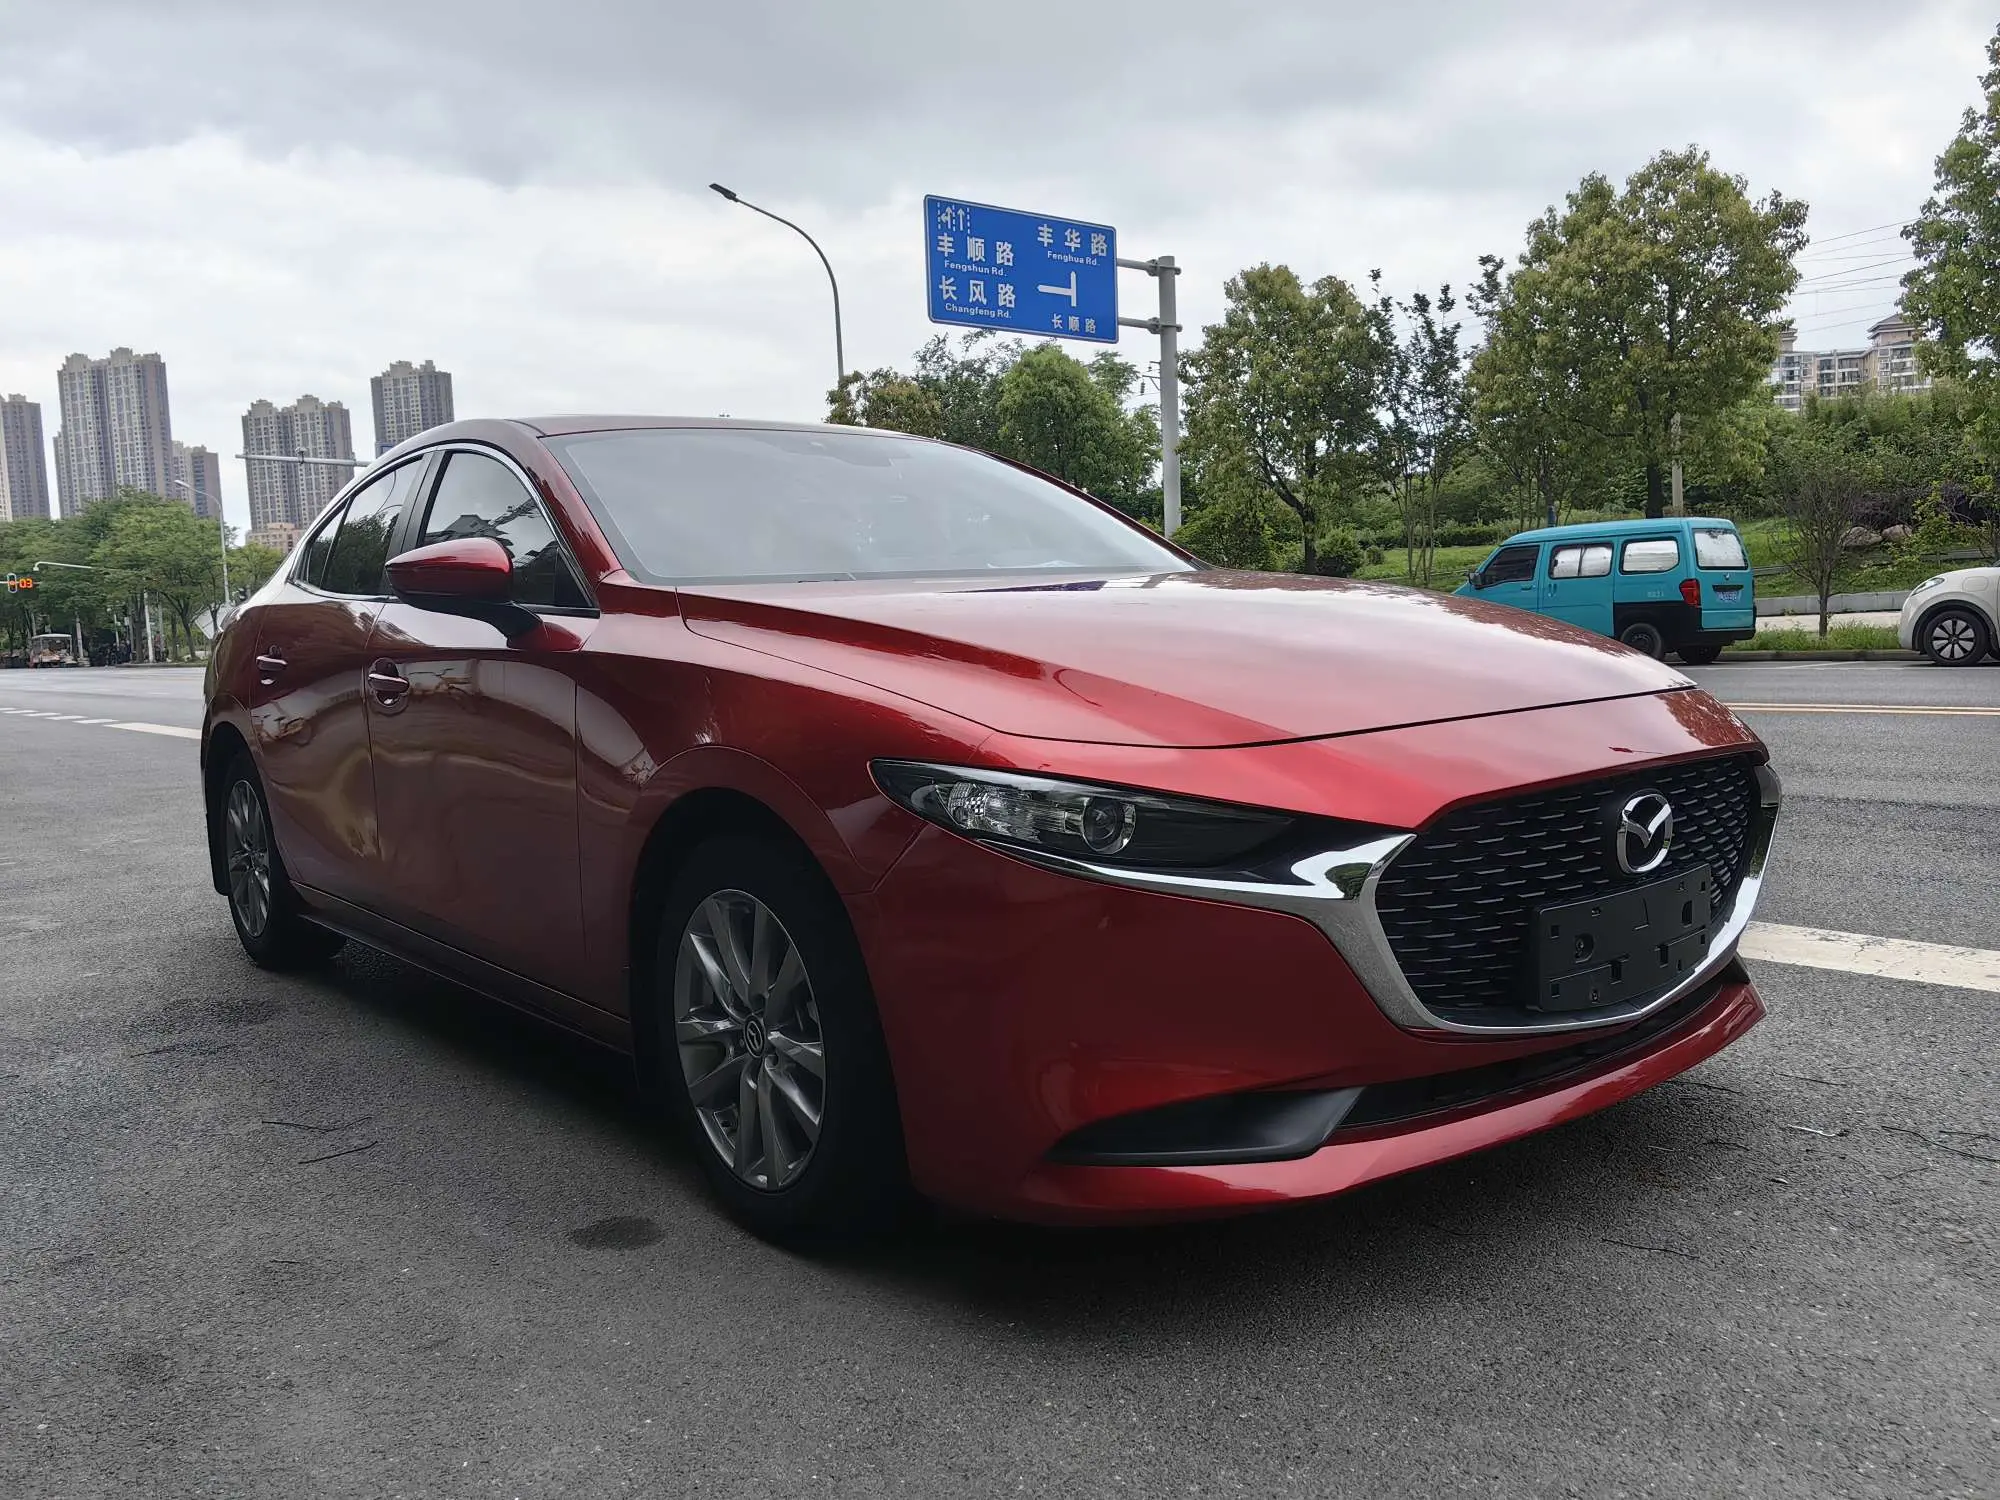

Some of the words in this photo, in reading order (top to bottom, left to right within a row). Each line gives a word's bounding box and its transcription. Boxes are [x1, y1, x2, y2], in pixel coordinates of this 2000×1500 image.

[937, 232, 1014, 267] 丰顺路
[1037, 223, 1107, 257] 丰华路
[1047, 251, 1084, 265] Fenghua
[944, 259, 990, 275] Fengshun
[991, 266, 1007, 277] Rd.
[939, 275, 1016, 308] 长风路
[945, 303, 996, 319] Changfeng
[997, 310, 1012, 319] Rd.
[1051, 313, 1096, 334] 长顺路
[19, 577, 33, 588] 03
